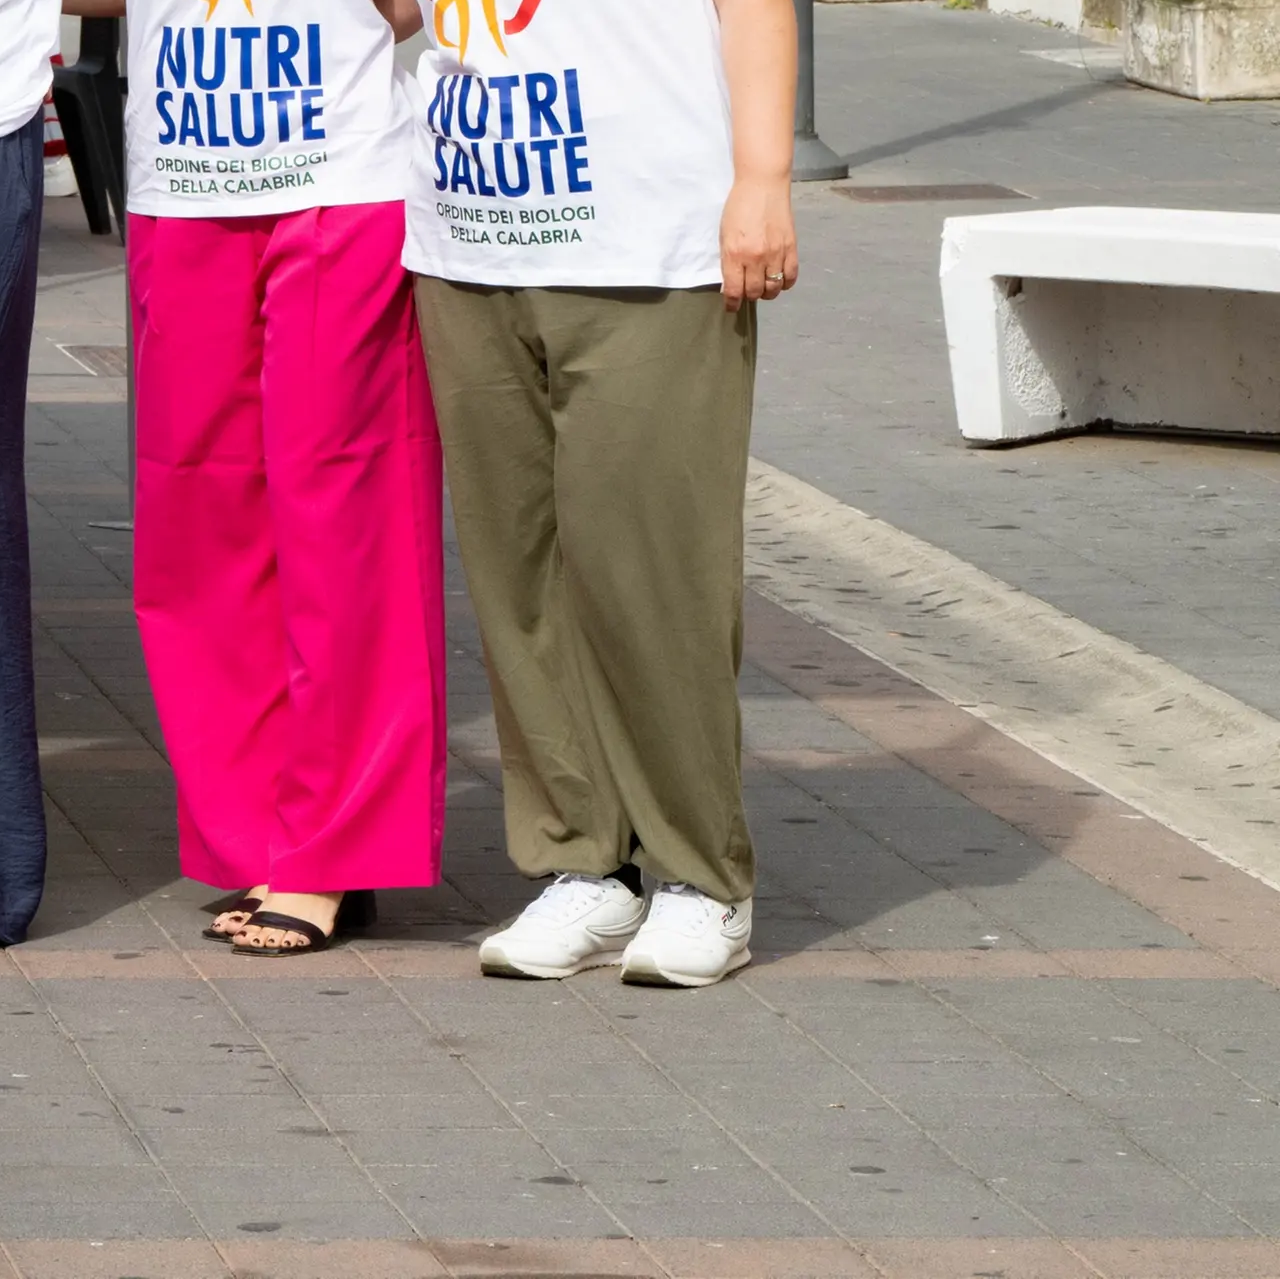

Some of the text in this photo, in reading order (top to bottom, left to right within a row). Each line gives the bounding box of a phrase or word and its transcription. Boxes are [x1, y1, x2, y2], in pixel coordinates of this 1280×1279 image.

[156, 24, 322, 90] NUTRI
[428, 69, 584, 140] NUTRI
[156, 89, 326, 147] SALUTE
[156, 152, 327, 173] ORDINE DEI BIOLOGI
[433, 136, 592, 198] SALUTE
[170, 172, 314, 193] DELLA CALABRIA
[437, 202, 595, 224] ORDINE DEI BIOLOGI
[451, 225, 582, 245] DELLA CALABRIA
[721, 904, 738, 927] FILA
